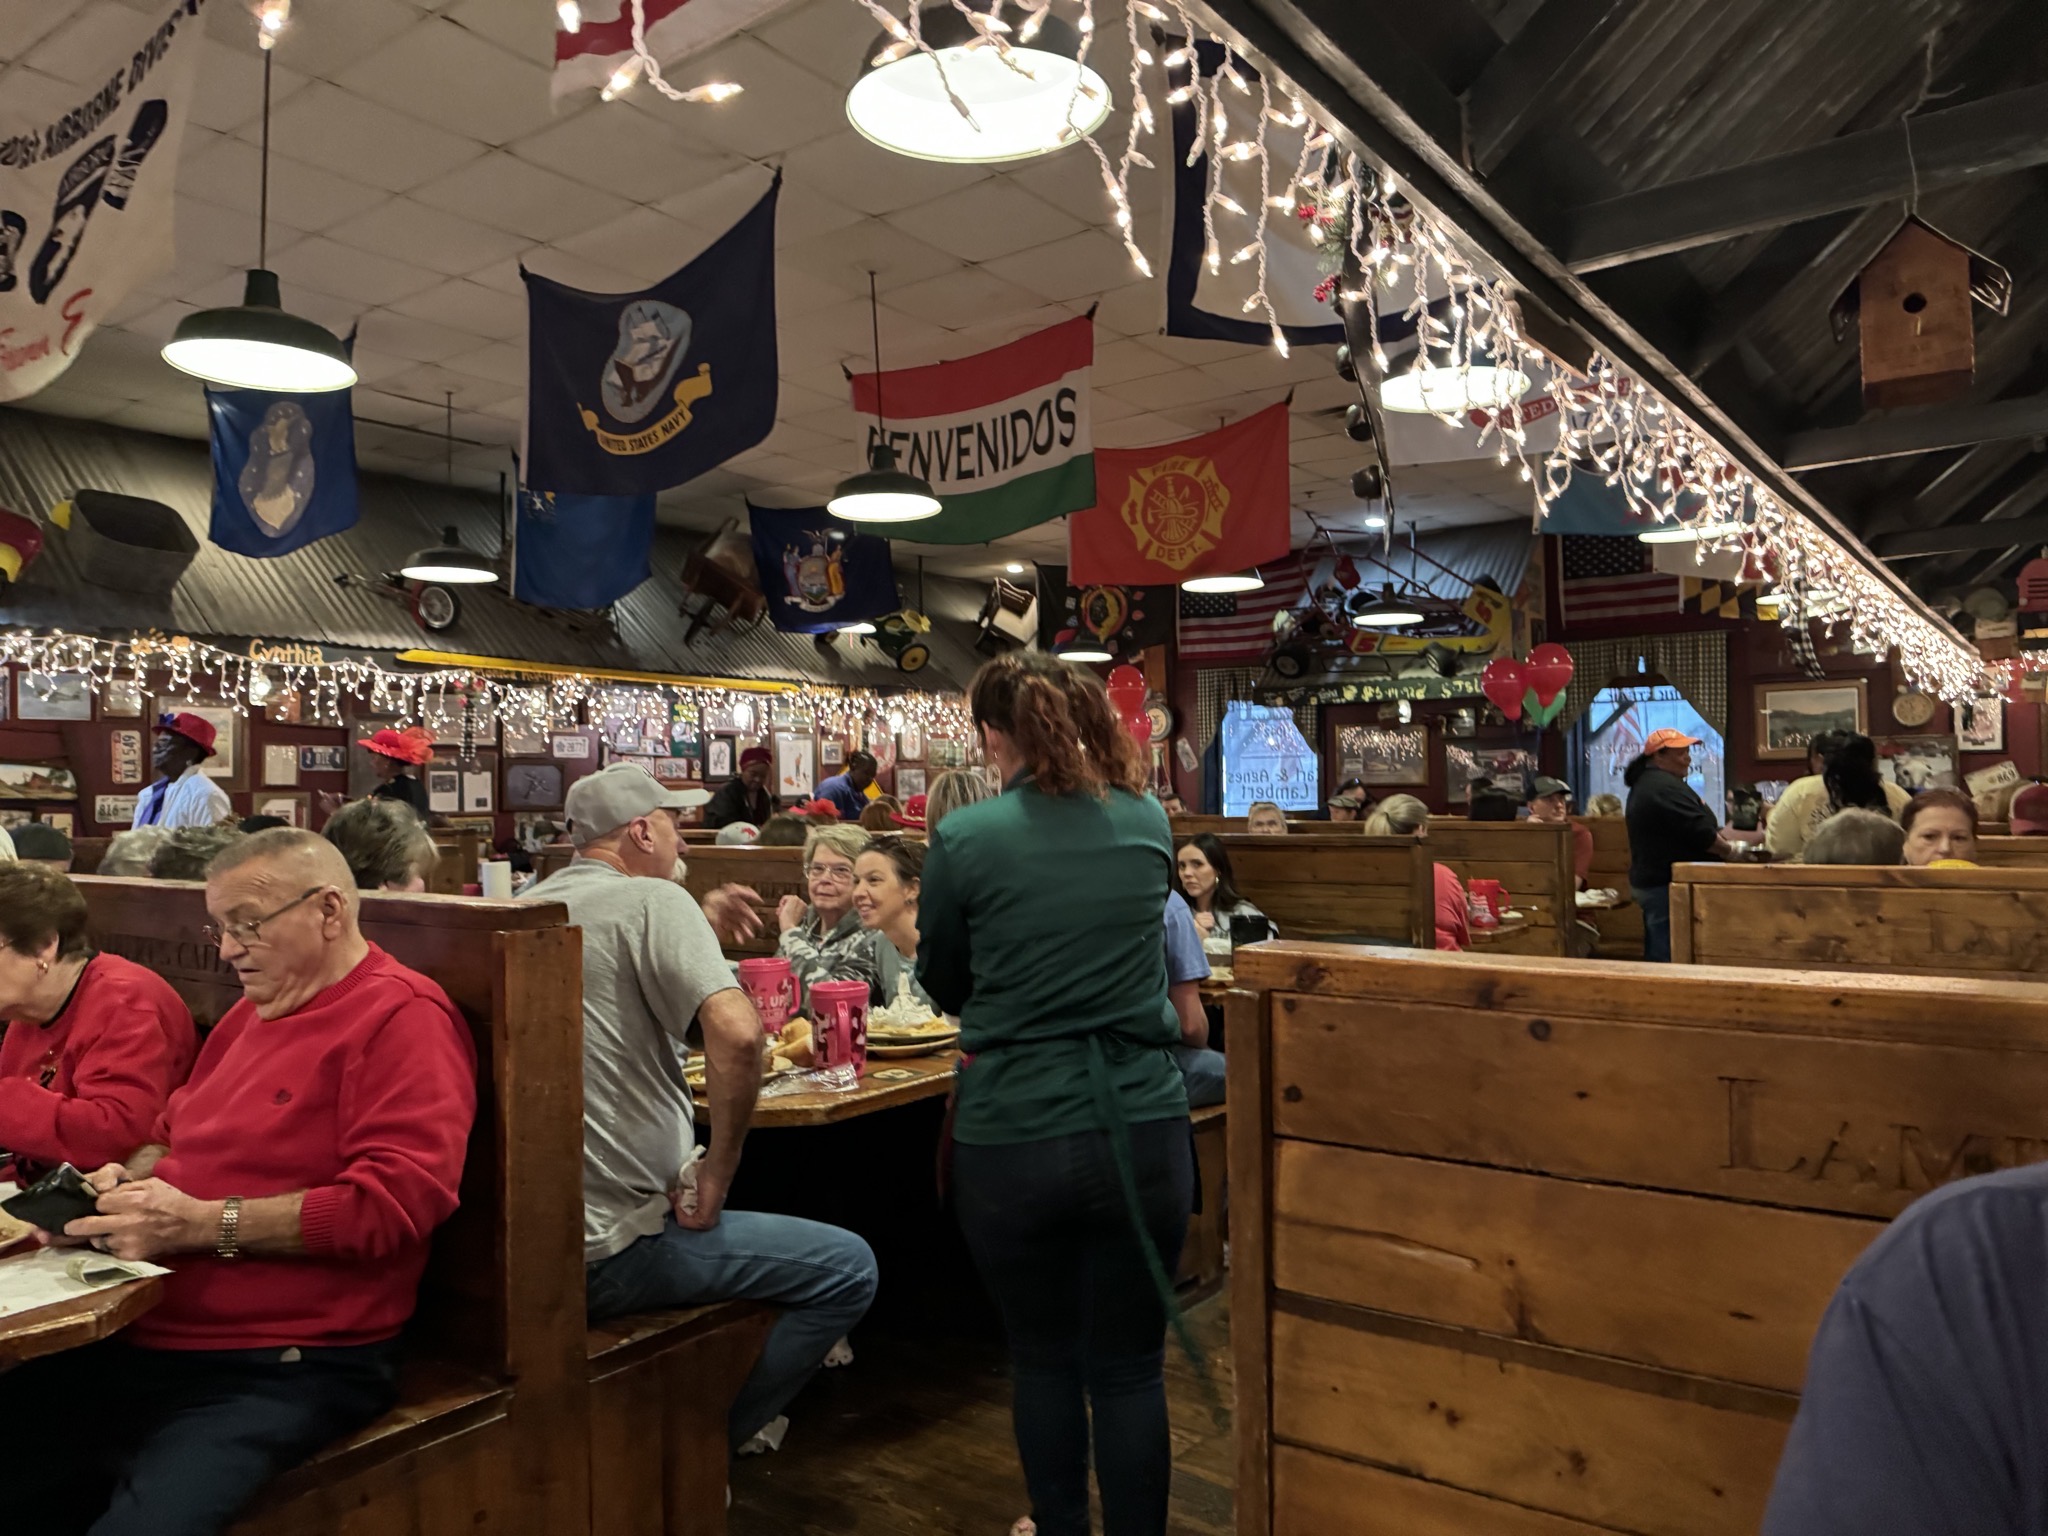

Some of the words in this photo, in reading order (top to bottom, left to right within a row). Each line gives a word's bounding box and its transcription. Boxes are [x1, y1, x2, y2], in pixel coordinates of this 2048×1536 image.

[629, 429, 660, 452] STATES
[661, 409, 688, 437] NAVY
[1152, 460, 1191, 477] FIRE
[1156, 541, 1202, 562] DEPT.
[250, 638, 323, 666] Cynthia
